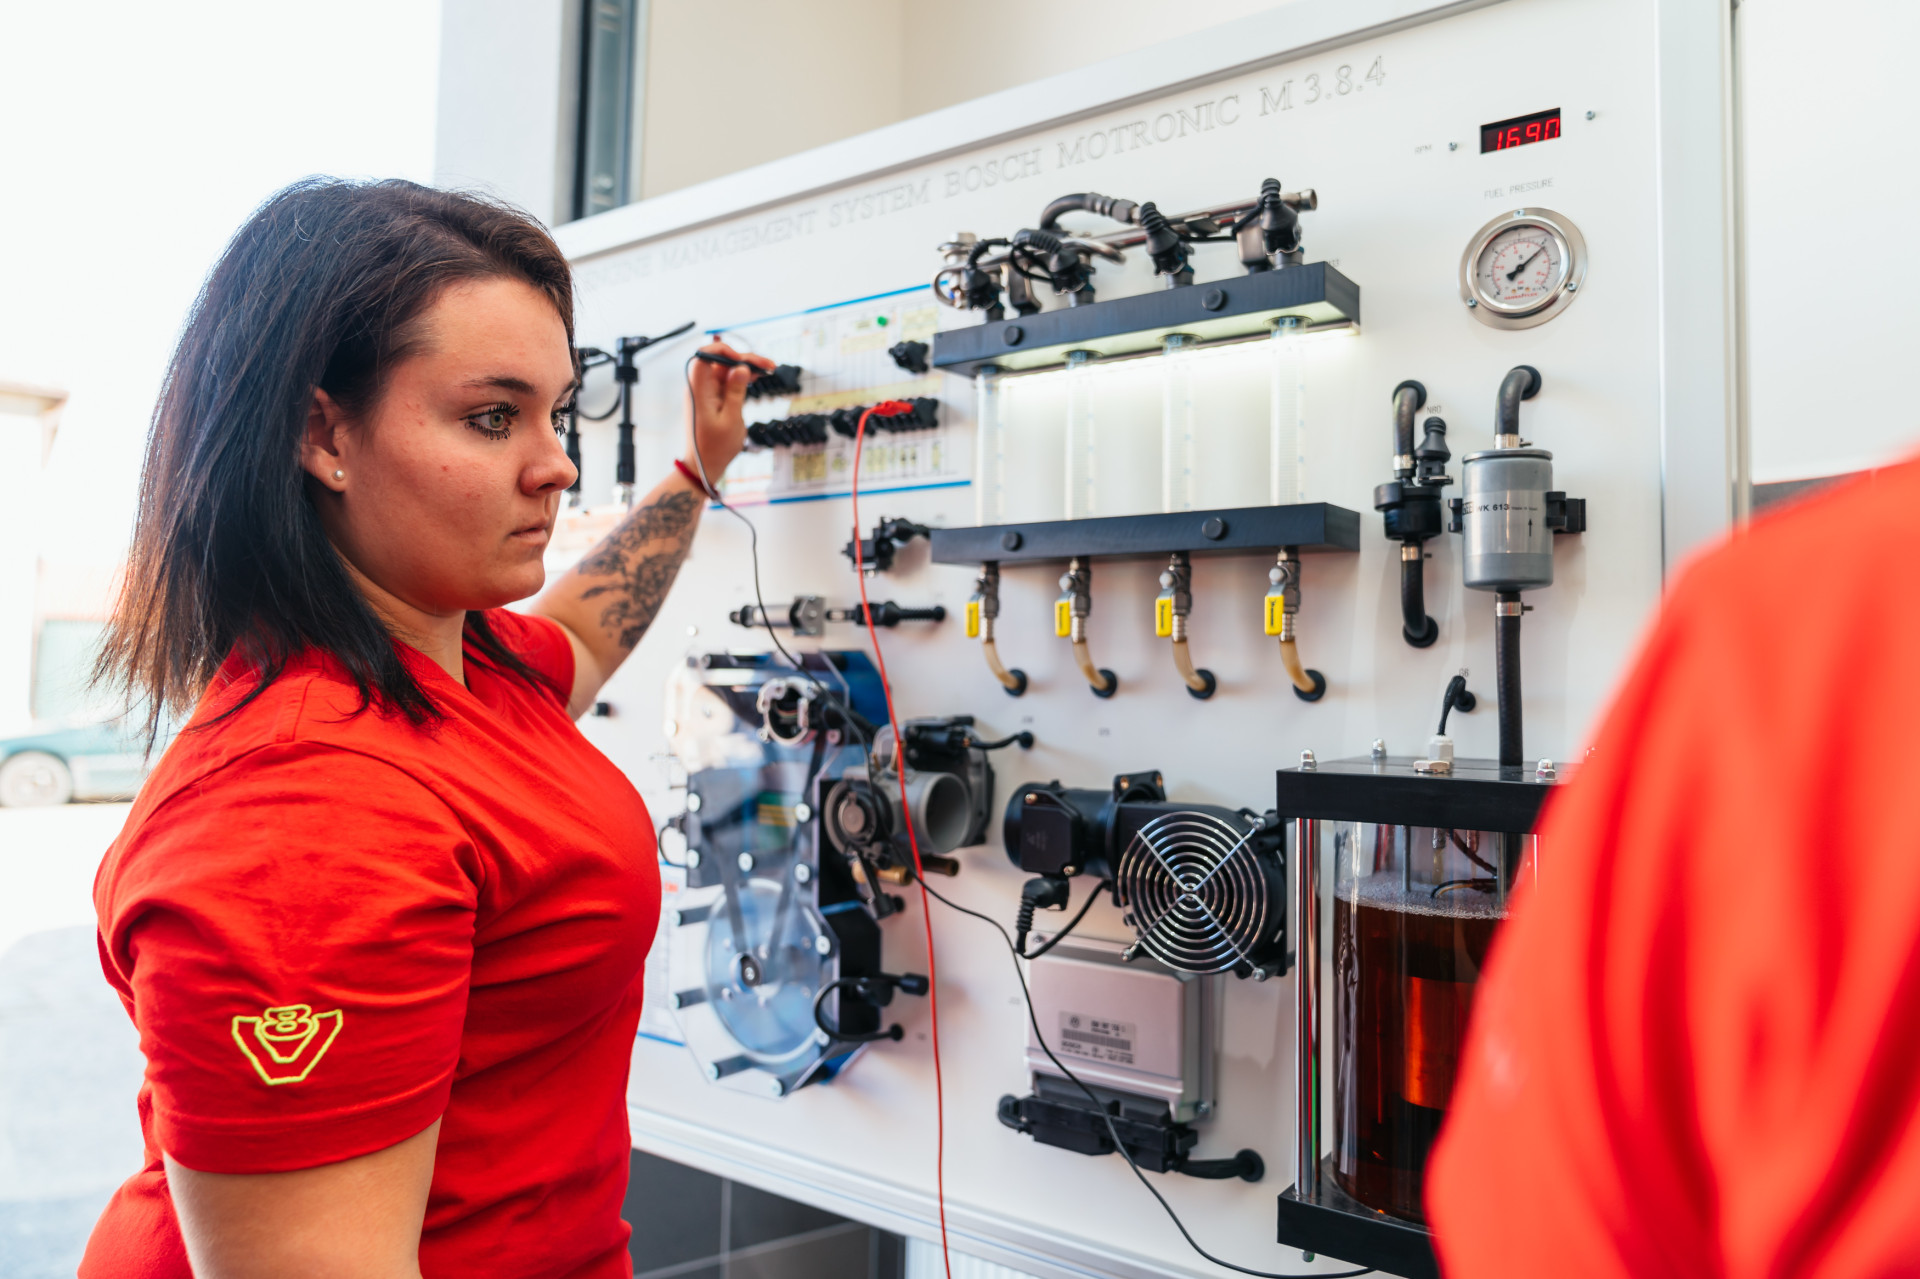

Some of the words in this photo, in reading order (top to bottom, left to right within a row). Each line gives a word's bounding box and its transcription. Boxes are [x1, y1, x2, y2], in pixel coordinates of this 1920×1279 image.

[1497, 117, 1560, 151] 1690
[660, 210, 817, 272] MANAGEMENT
[829, 177, 931, 229] SYSTEM
[944, 148, 1042, 199] BOSCH
[1057, 95, 1241, 169] MOTRONIC
[1304, 55, 1387, 105] 3.8.4
[1484, 187, 1504, 200] FUEL
[1509, 177, 1554, 195] PRESSURE
[1492, 503, 1510, 512] 613
